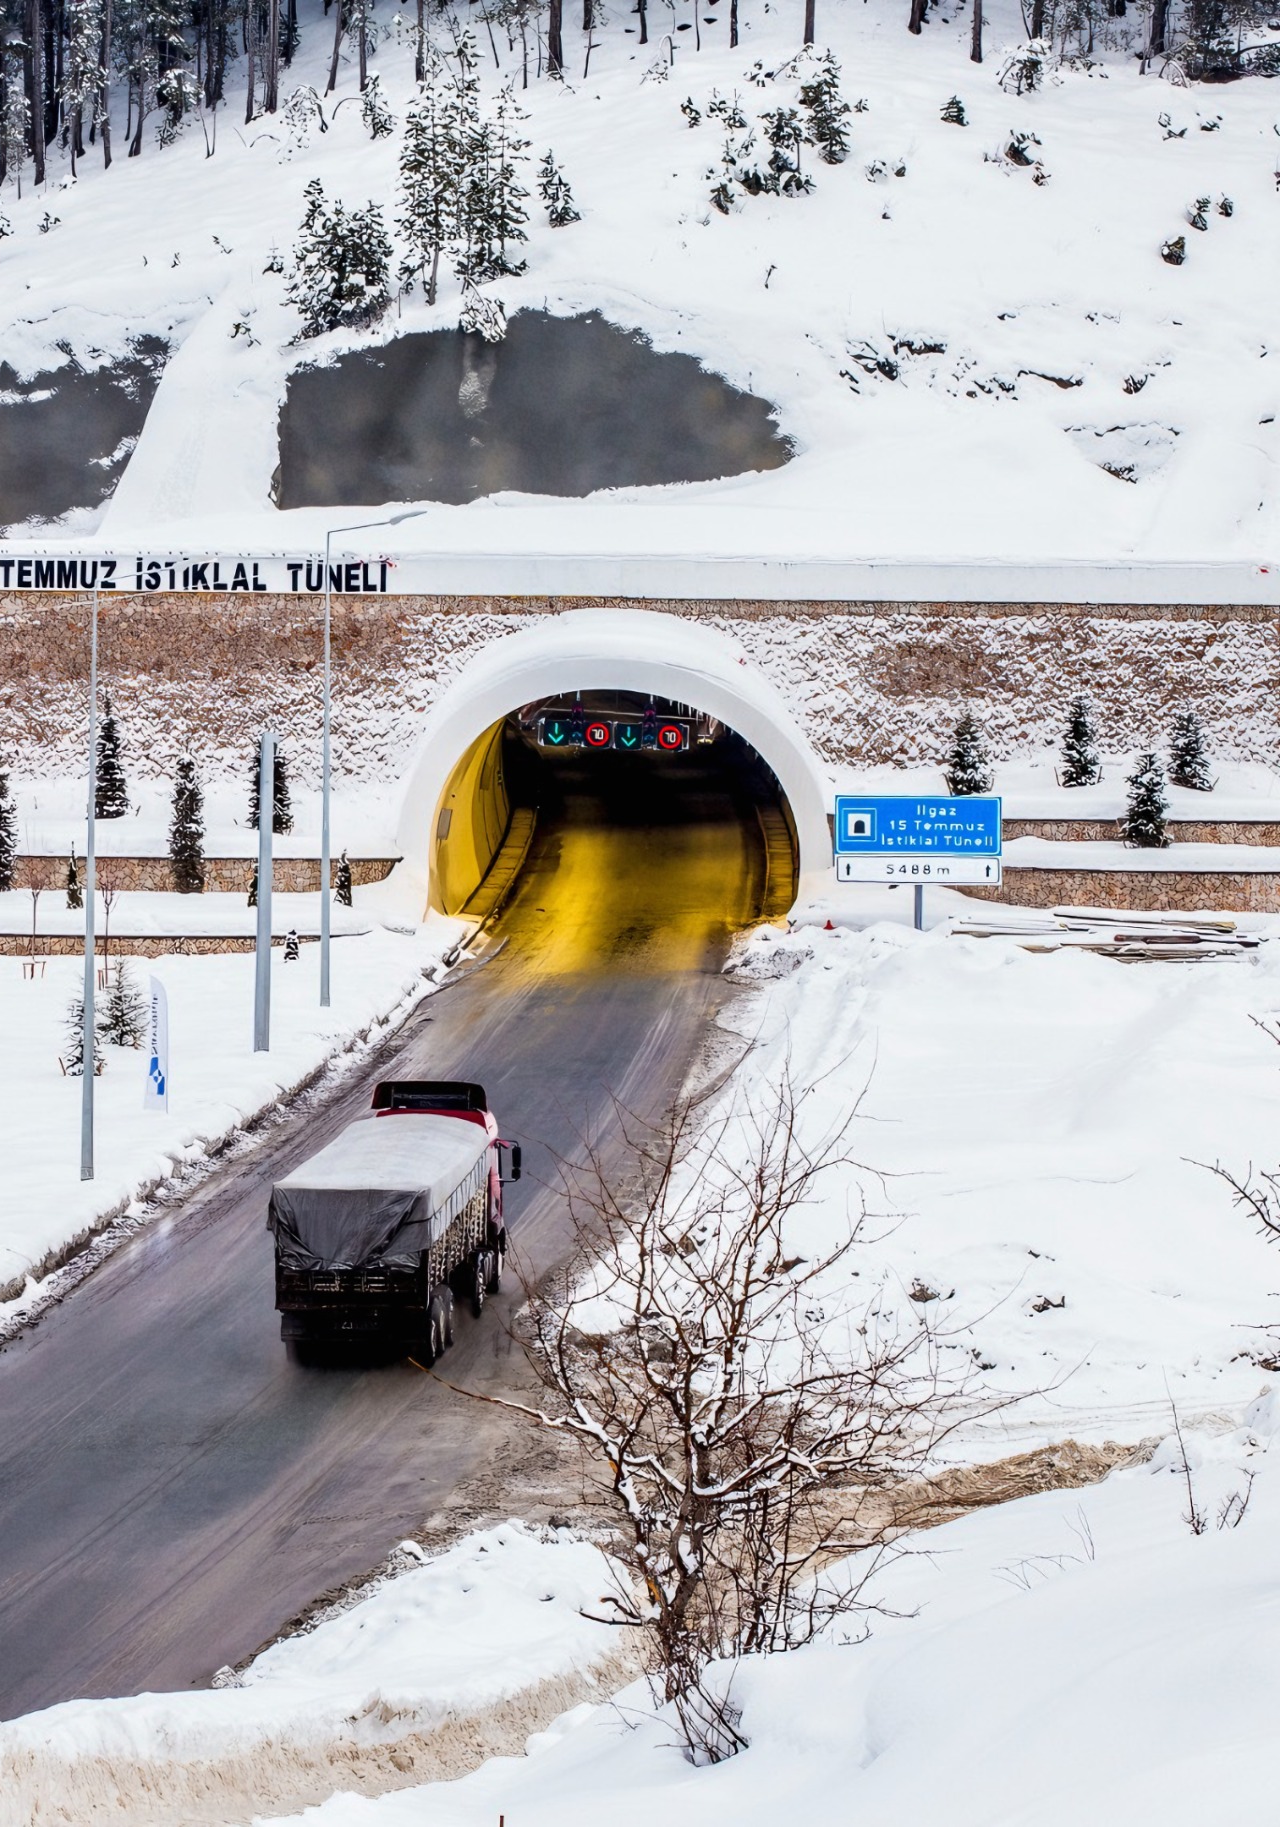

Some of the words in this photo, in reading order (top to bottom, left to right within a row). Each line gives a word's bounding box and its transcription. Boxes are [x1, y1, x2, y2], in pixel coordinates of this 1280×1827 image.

[0, 559, 117, 589] TEMMUZ
[135, 556, 267, 591] İSTİKLAL
[591, 728, 604, 740] 70
[664, 731, 677, 743] 70
[917, 804, 957, 818] Ilgaz
[889, 820, 907, 831] 15
[914, 820, 985, 831] Temmuz
[886, 864, 931, 875] 5488
[937, 866, 950, 875] m
